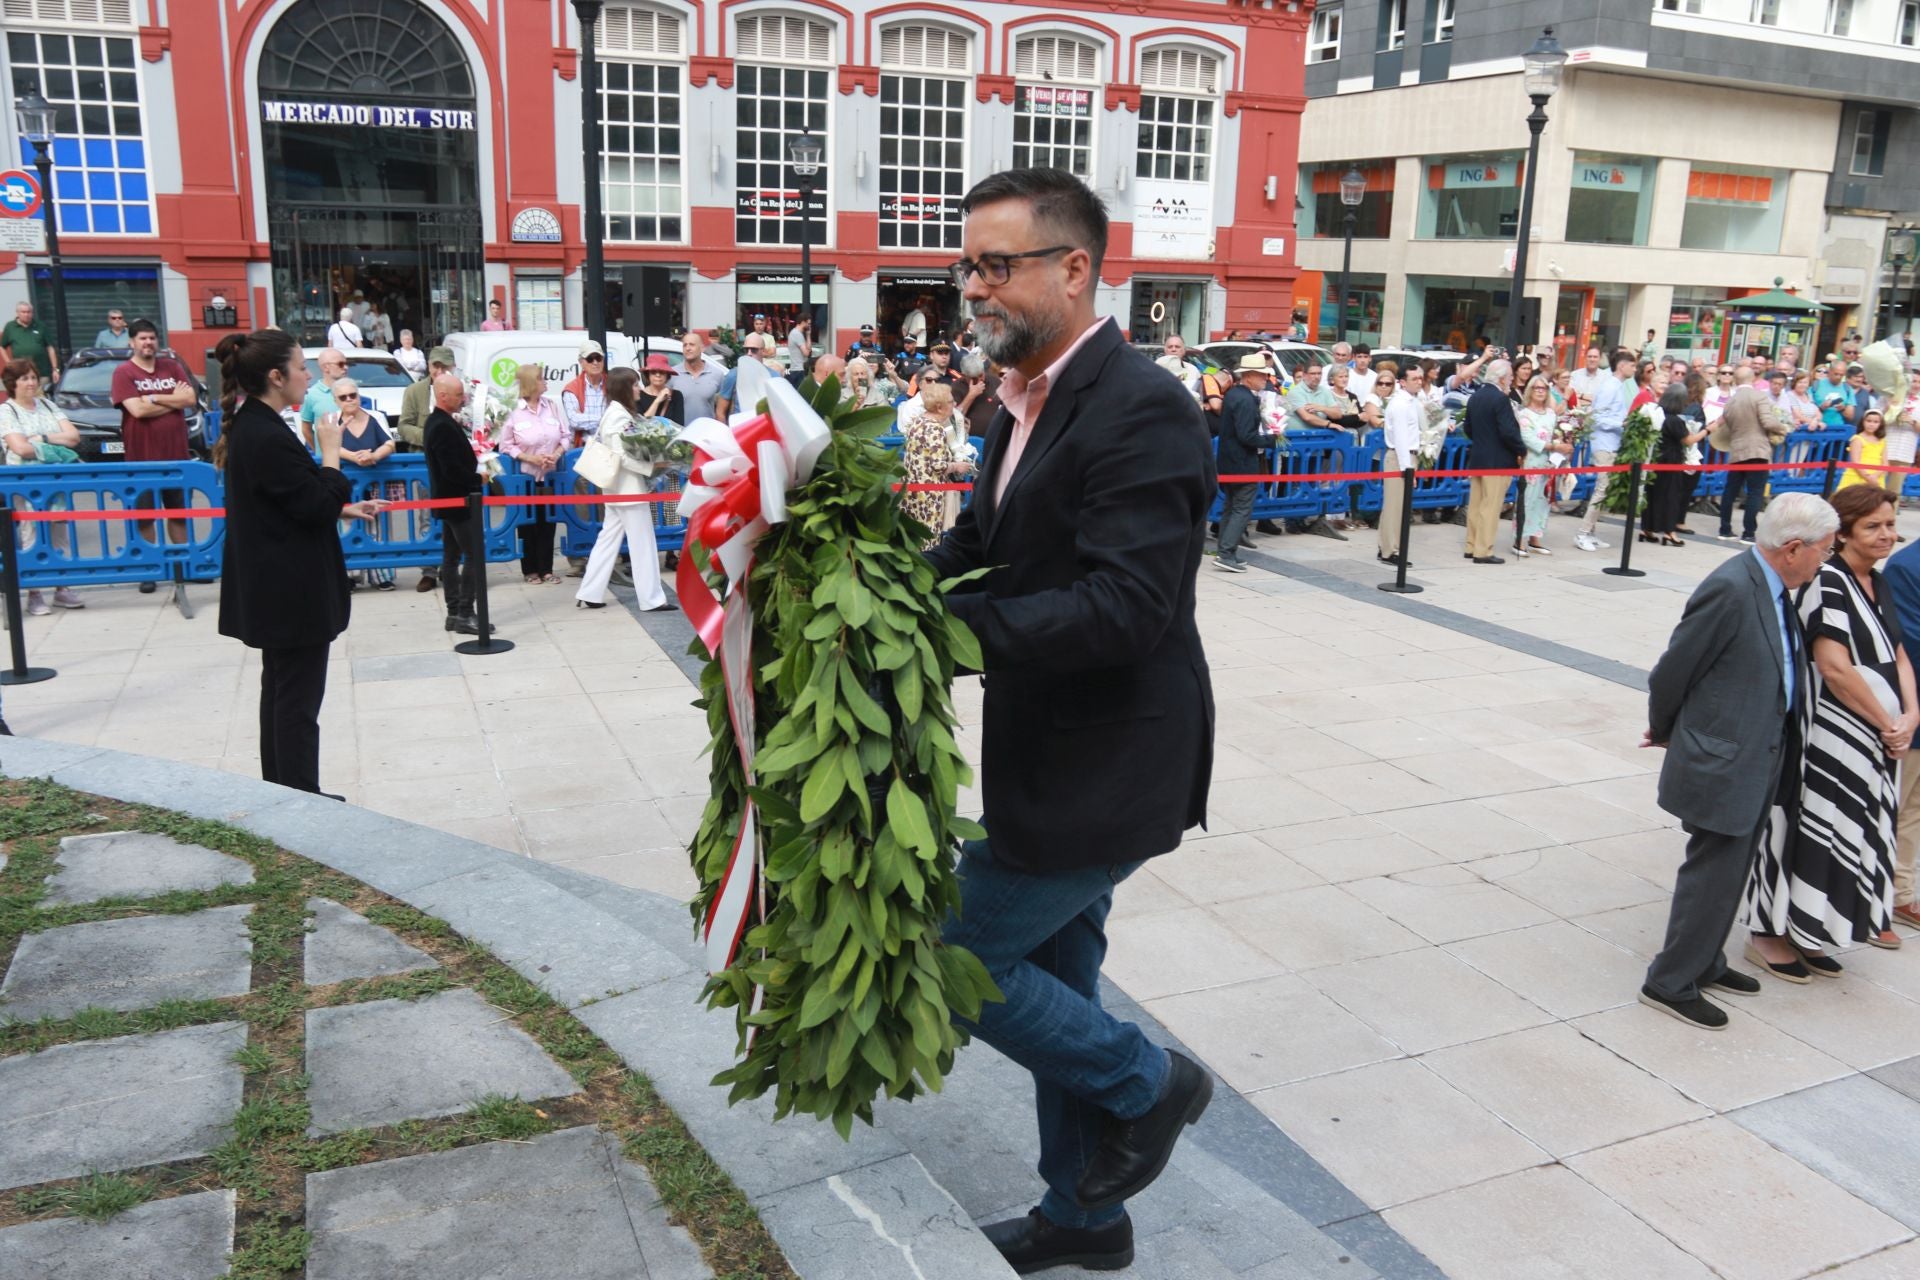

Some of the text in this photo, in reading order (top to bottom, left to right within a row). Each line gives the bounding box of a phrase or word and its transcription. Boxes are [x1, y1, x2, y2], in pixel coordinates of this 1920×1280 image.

[265, 101, 474, 129] MERCADO DEL SUR
[1459, 169, 1483, 182] ING
[1583, 169, 1608, 183] ING
[739, 198, 750, 206] La
[750, 198, 768, 207] Csa
[769, 200, 785, 208] Rel
[786, 200, 798, 208] del
[882, 203, 892, 211] La
[892, 203, 909, 211] Csa
[909, 204, 924, 212] Rel
[925, 204, 936, 212] del
